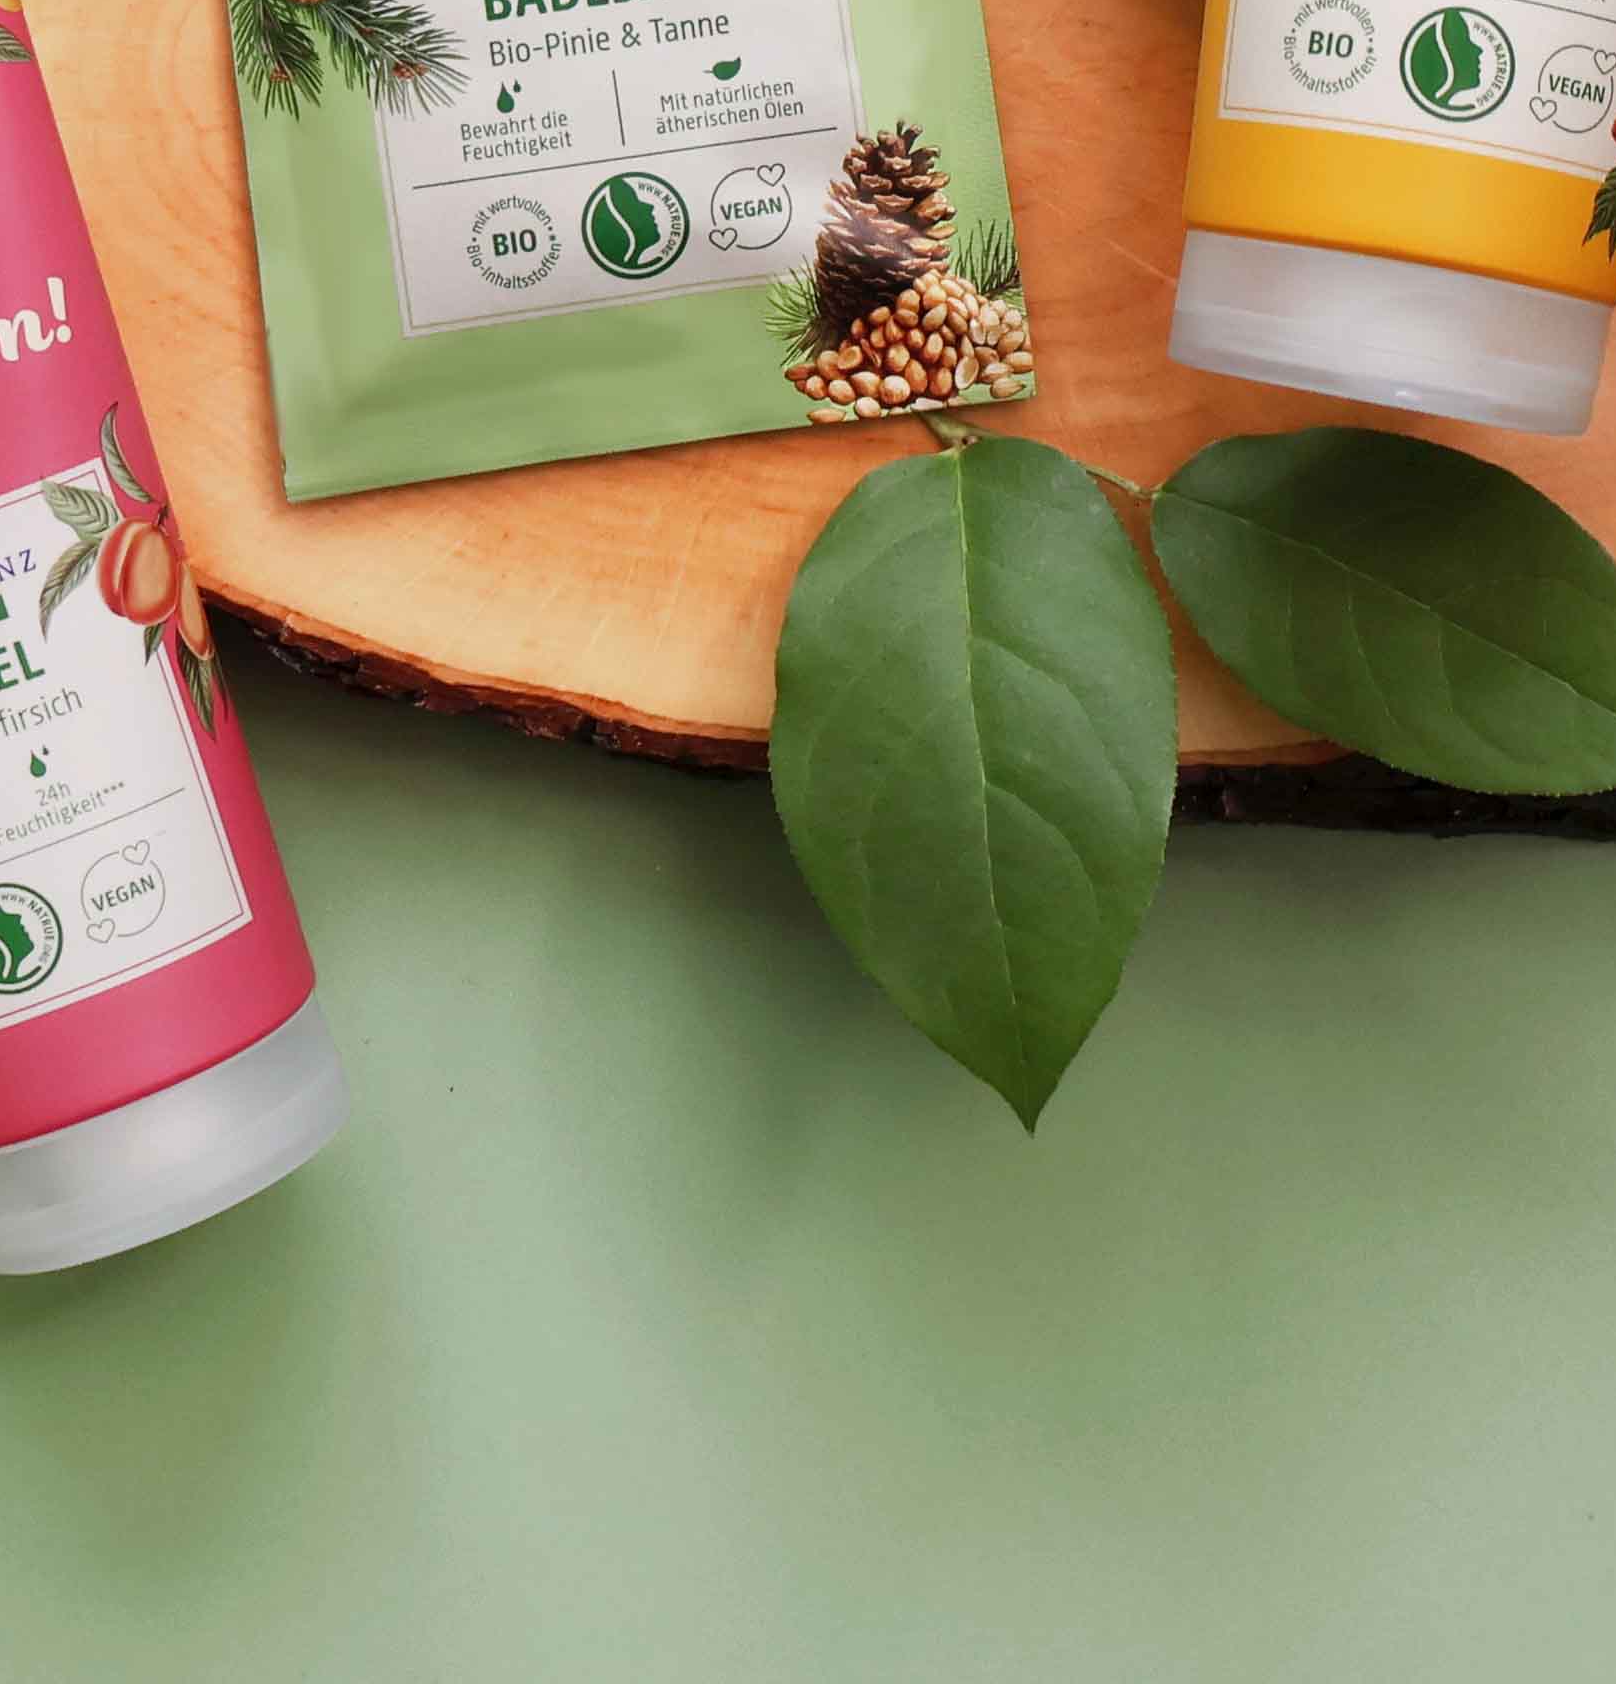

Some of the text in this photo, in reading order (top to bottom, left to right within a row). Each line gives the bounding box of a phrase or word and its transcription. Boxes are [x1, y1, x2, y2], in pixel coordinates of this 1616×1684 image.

[489, 14, 730, 67] Bio-Pinie & Tanne
[1308, 30, 1354, 58] BIO
[660, 80, 794, 113] Mit natürlichen
[1549, 73, 1606, 104] VEGAN
[460, 111, 568, 141] Bewahrt die
[656, 98, 804, 135] ätherischen Ölen
[462, 131, 572, 162] Feuchtigkeit
[472, 195, 551, 234] mit wertvollen
[720, 196, 783, 221] VEGAN
[492, 229, 537, 257] BIO
[36, 780, 71, 806] 24h
[91, 874, 155, 913] VEGAN
